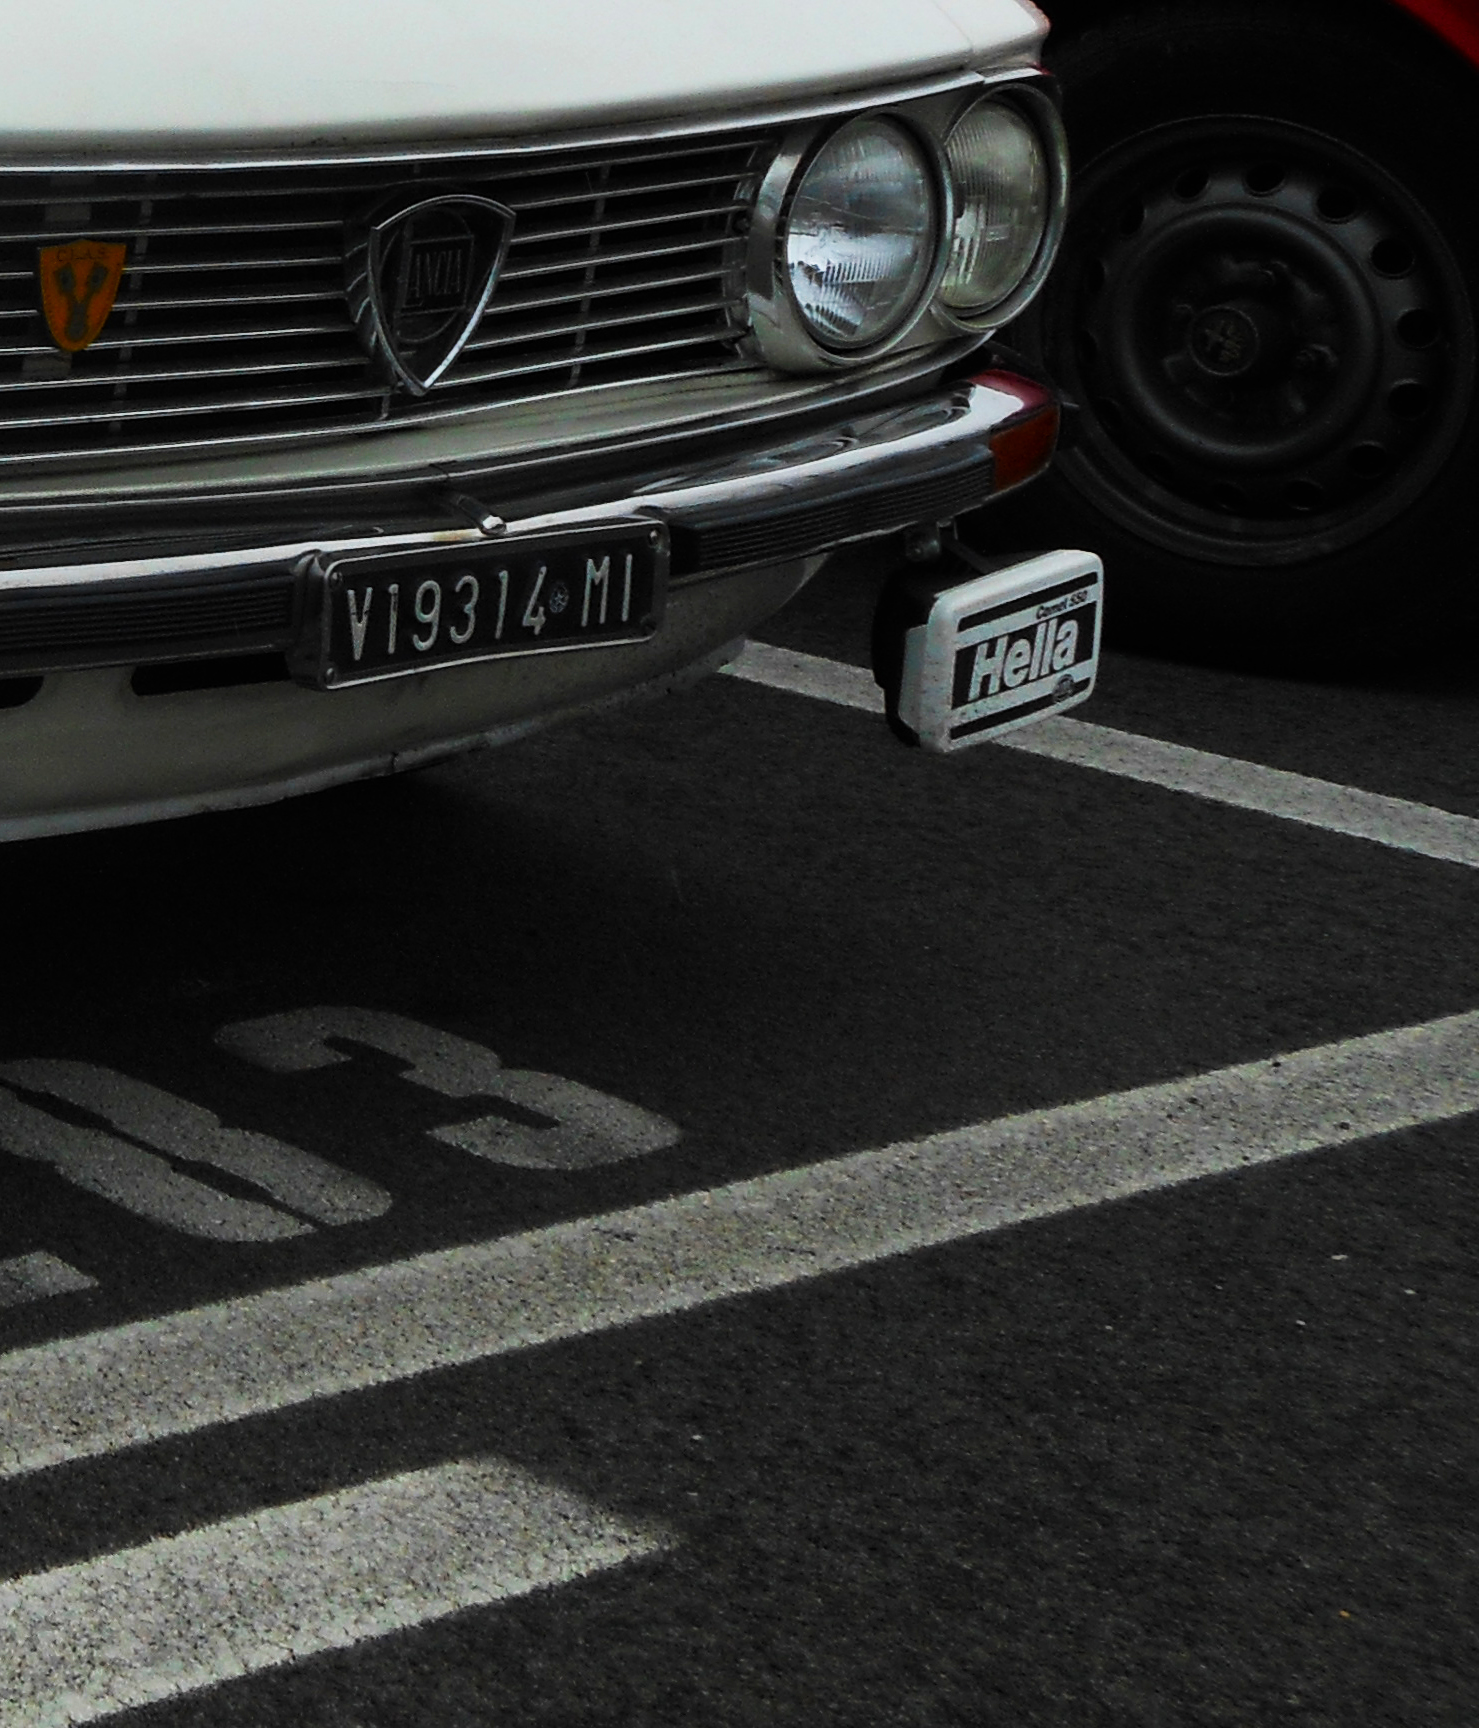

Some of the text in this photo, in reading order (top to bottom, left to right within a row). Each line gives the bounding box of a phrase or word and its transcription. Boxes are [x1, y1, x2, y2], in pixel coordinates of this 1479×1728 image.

[403, 246, 463, 307] LANCIA
[581, 554, 632, 627] MI
[968, 618, 1078, 701] Hella
